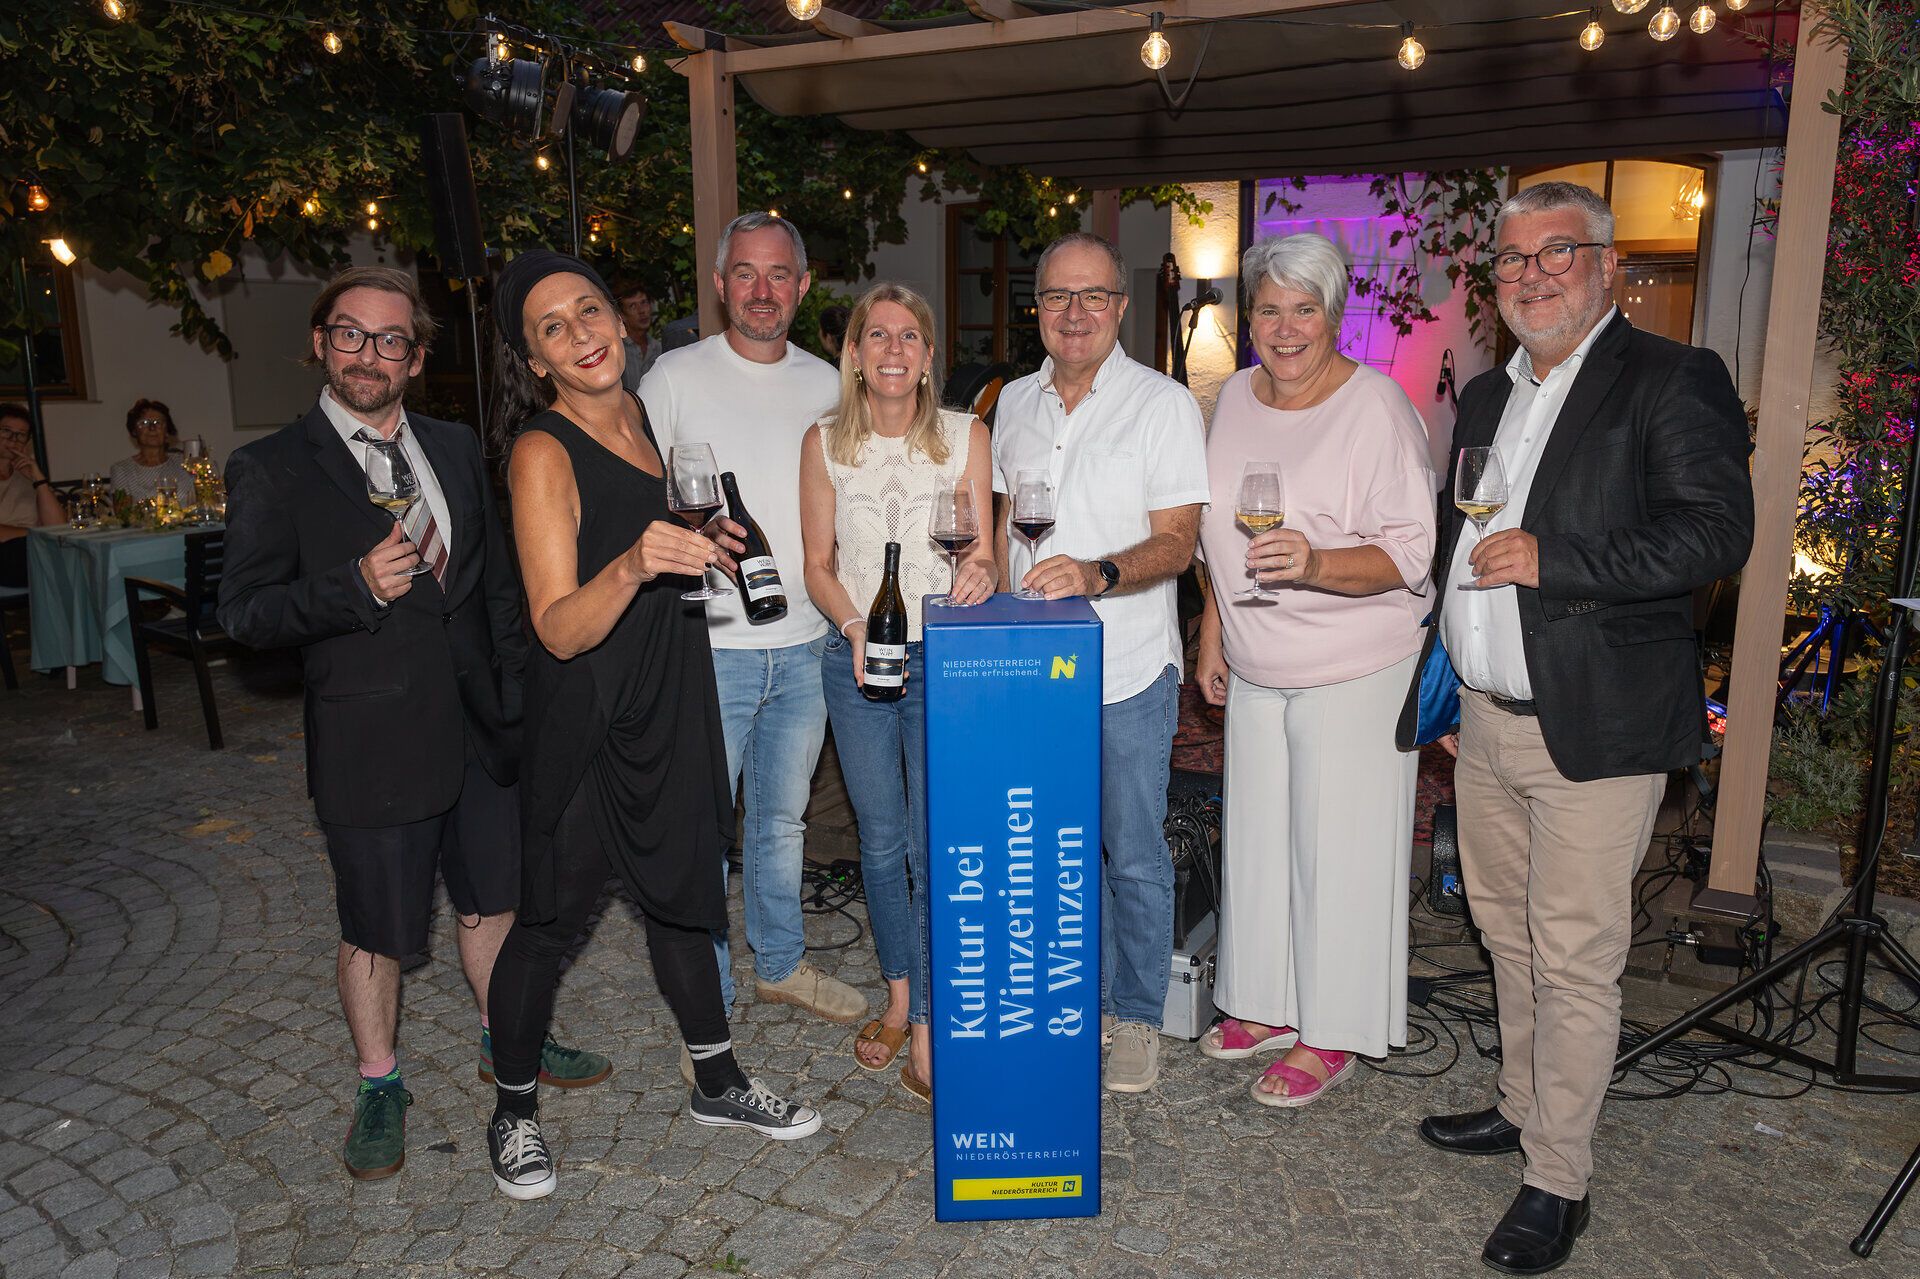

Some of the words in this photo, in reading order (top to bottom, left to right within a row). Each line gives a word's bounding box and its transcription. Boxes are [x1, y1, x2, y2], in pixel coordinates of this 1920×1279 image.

[943, 659, 1041, 669] NIEDERÖSTERREICH
[943, 669, 979, 678] Einfach
[982, 669, 1042, 677] erfrischend.
[947, 844, 985, 903] bei
[998, 786, 1035, 1040] Winzerinnen
[1047, 825, 1083, 993] Winzern
[949, 917, 987, 1040] Kultur
[1047, 1006, 1083, 1037] &
[952, 1132, 1015, 1149] WEIN
[956, 1149, 1080, 1161] NIEDERÖSTERREICH
[991, 1187, 1058, 1195] NIEDERÖSTERREICH
